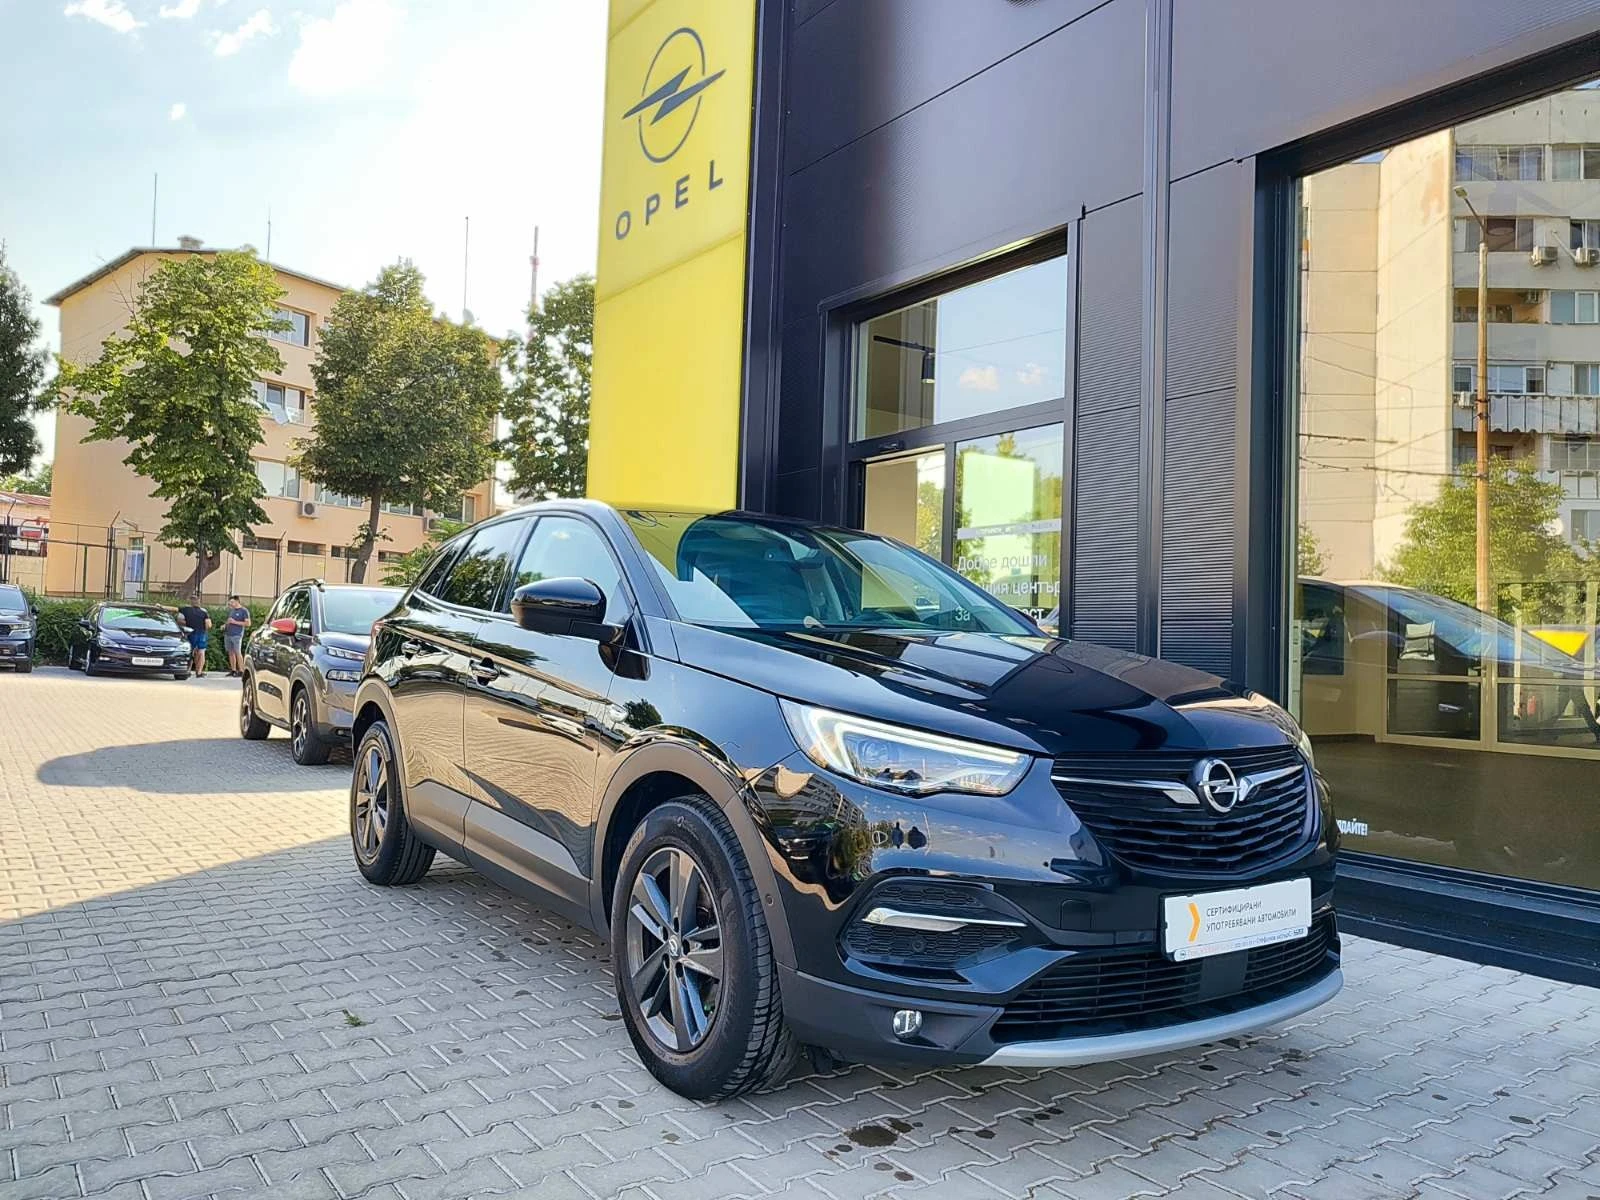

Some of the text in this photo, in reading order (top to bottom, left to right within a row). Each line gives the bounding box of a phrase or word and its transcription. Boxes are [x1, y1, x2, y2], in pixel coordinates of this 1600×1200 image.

[615, 159, 724, 240] OPEL
[957, 554, 1048, 573] Добре дошли
[1012, 581, 1060, 597] център
[1206, 900, 1262, 917] СЕРТИФИЦИРАНИ
[1206, 908, 1297, 932] УПОТРЕБЯВАНИ АВТОМОБИЛИ
